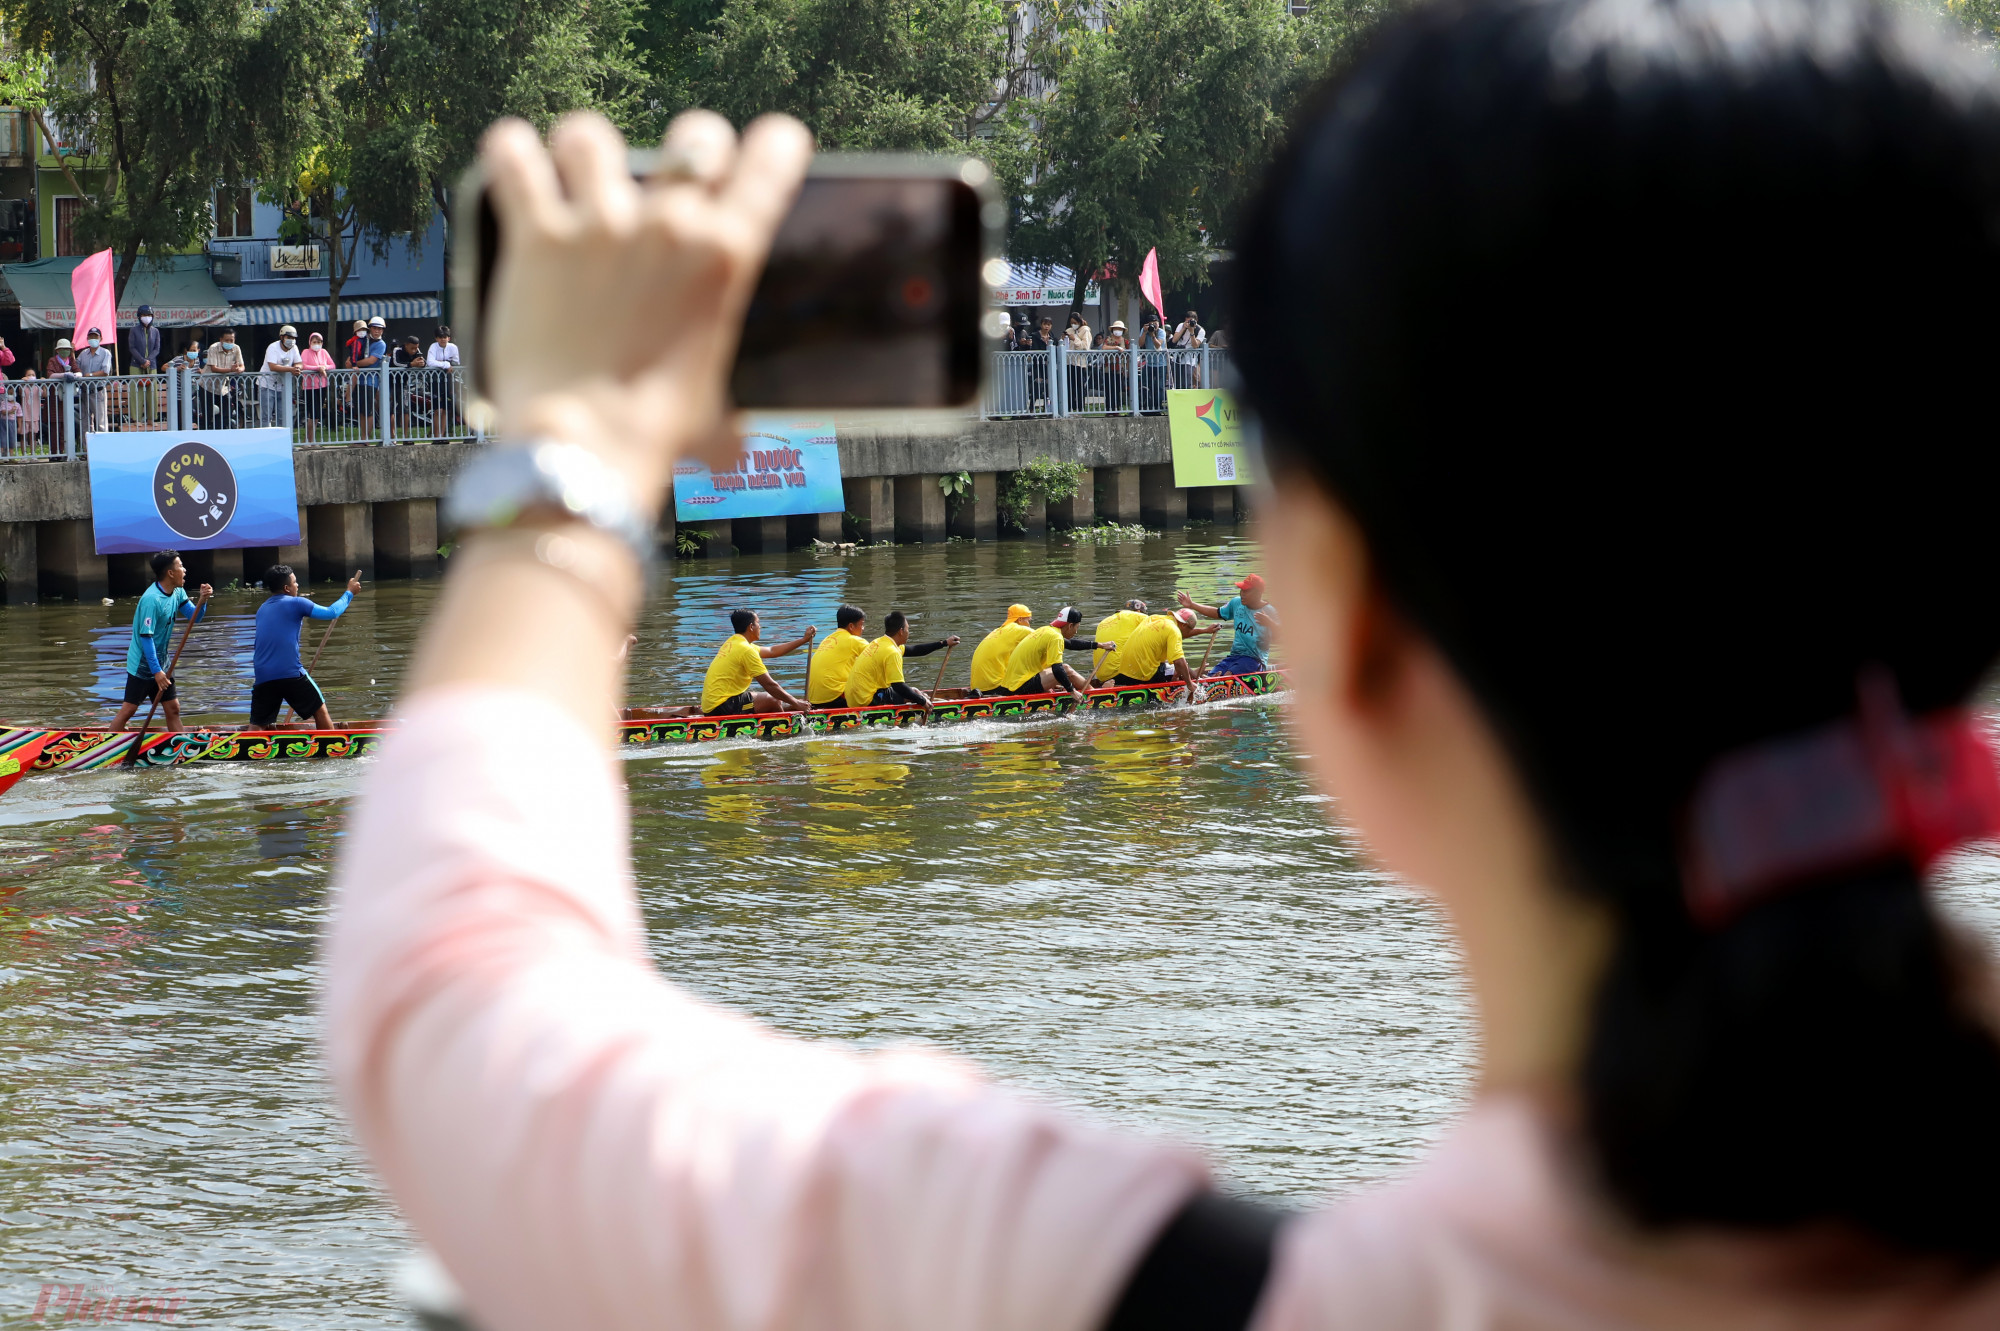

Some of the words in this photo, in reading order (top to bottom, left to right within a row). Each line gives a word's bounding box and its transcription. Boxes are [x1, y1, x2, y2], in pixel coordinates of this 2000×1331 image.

[1016, 290, 1030, 300] Sinh
[45, 311, 63, 320] BIA
[163, 453, 204, 507] SAIGON
[783, 472, 806, 487] VUI
[1235, 622, 1254, 636] AIA
